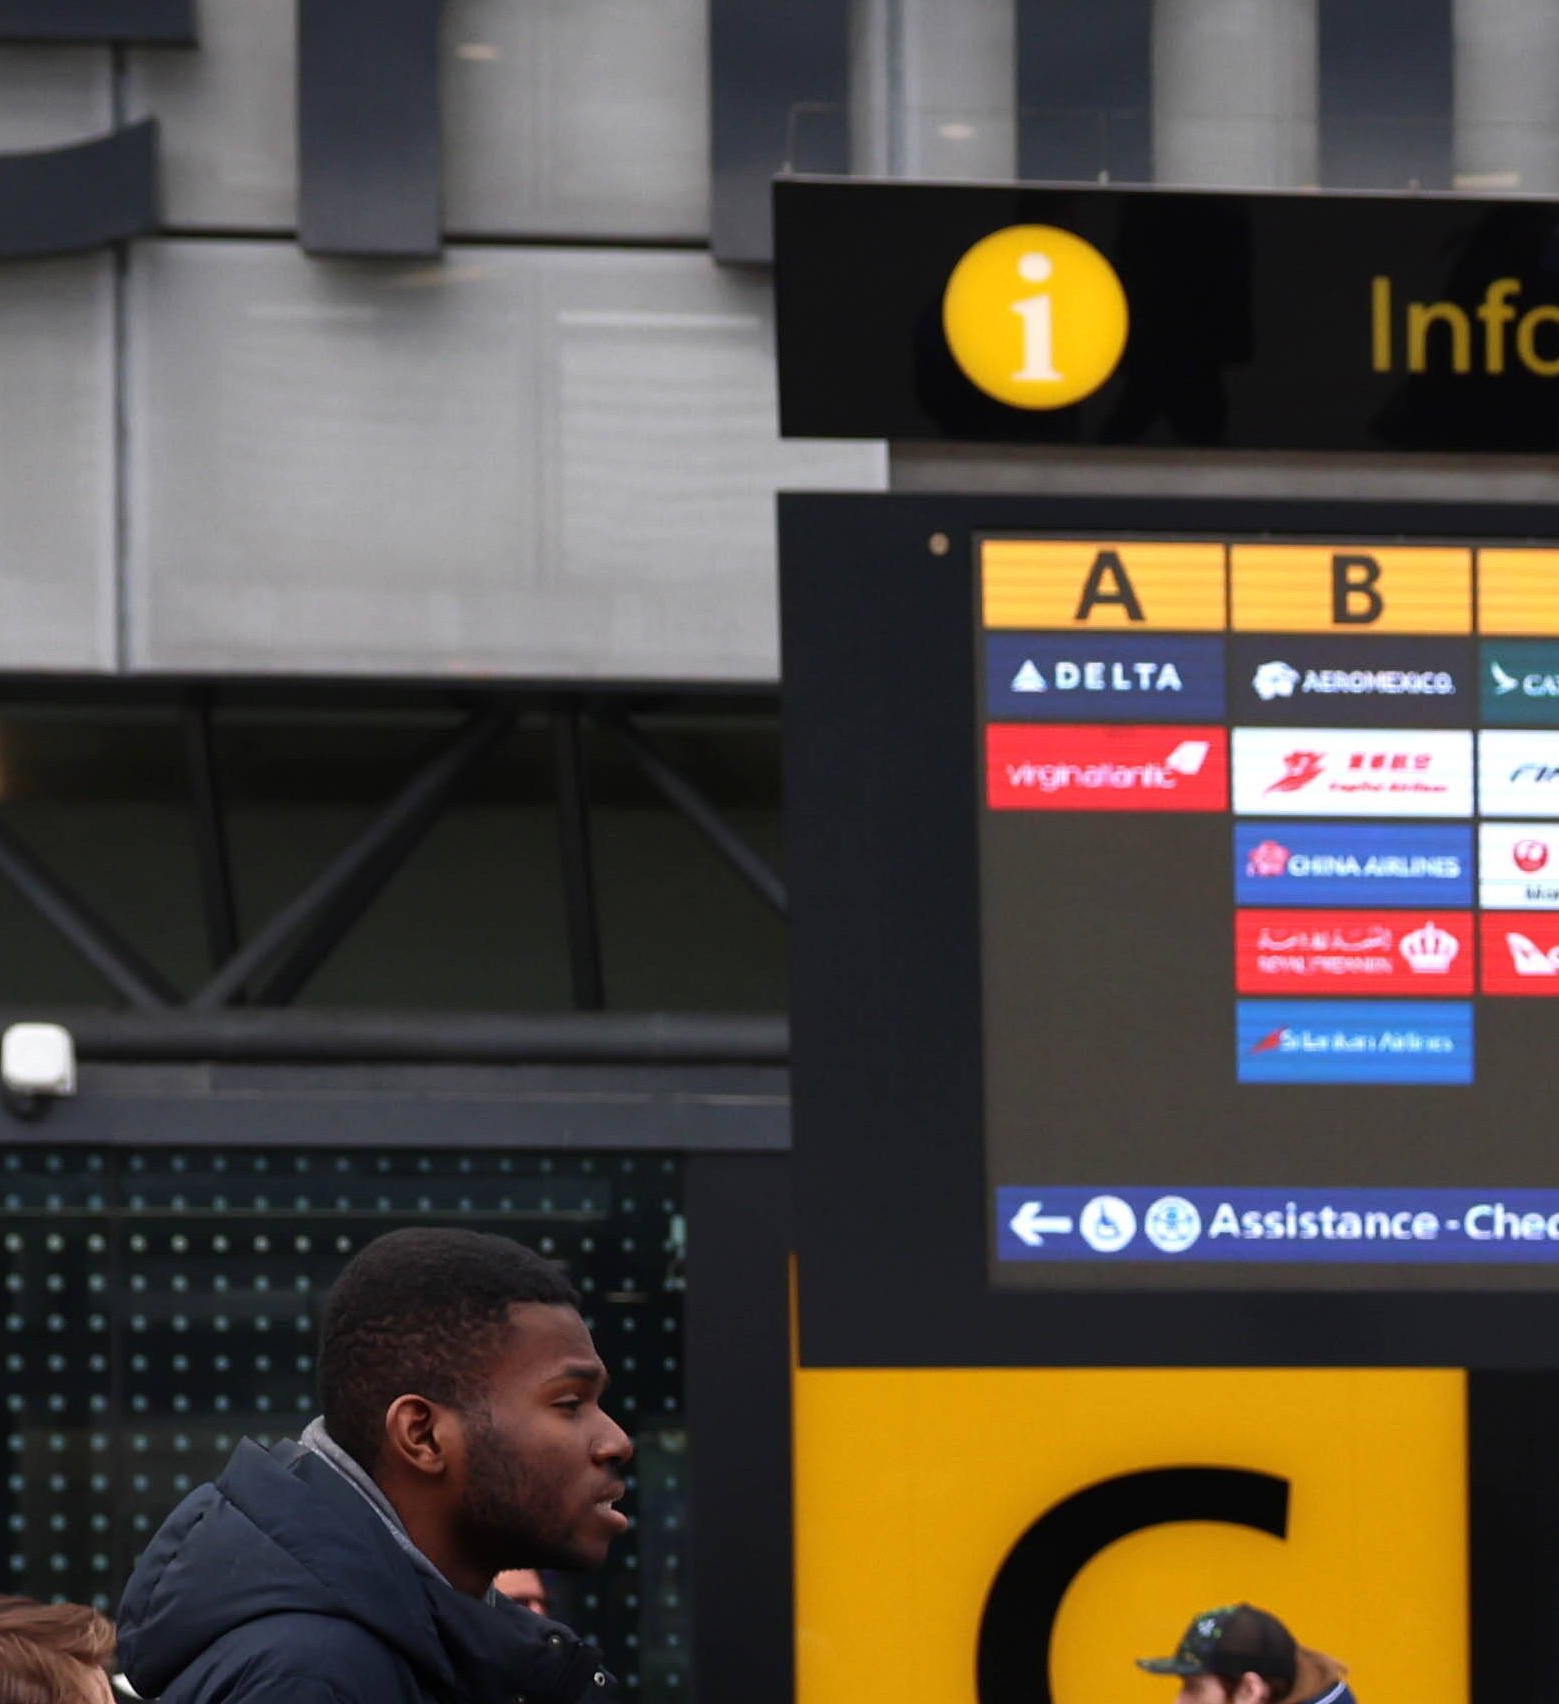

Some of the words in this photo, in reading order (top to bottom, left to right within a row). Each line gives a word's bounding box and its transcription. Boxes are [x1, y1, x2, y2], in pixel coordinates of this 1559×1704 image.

[1074, 549, 1146, 622] A
[1331, 554, 1385, 625] B
[1054, 661, 1184, 691] DELTA
[1288, 854, 1361, 878] CHINA
[1364, 855, 1461, 879] AIRLINES
[1208, 1201, 1440, 1241] Assistance
